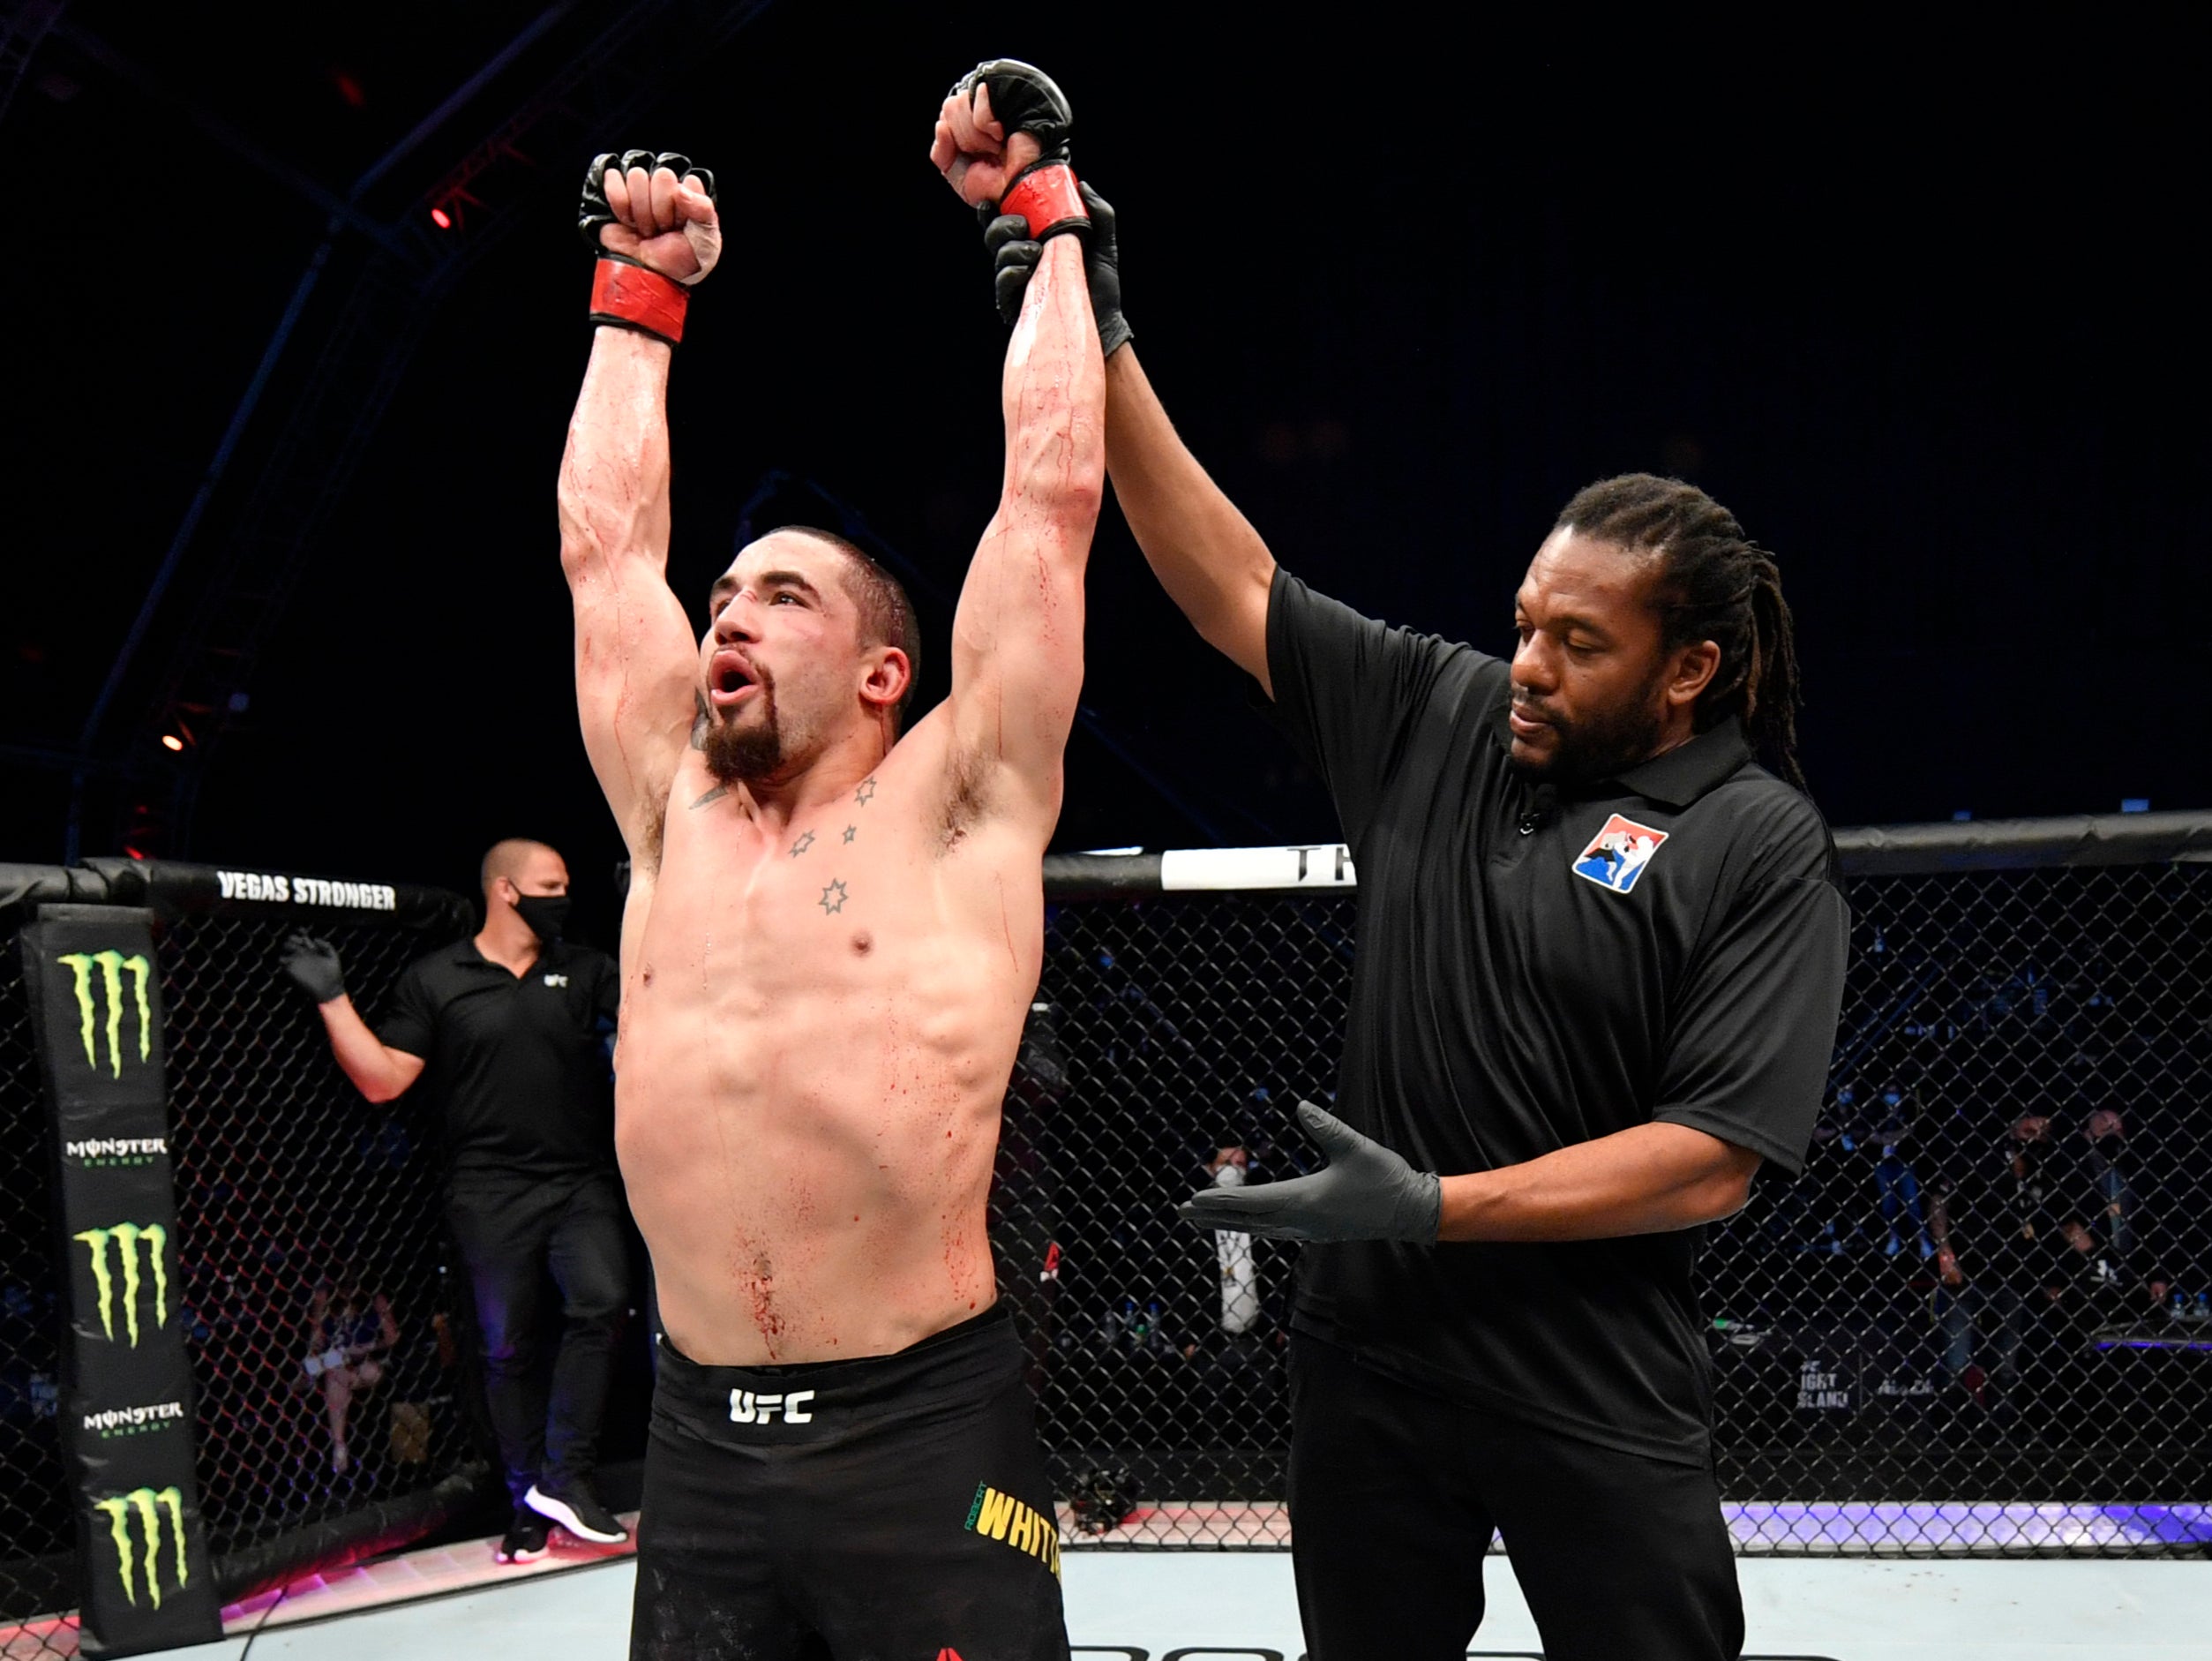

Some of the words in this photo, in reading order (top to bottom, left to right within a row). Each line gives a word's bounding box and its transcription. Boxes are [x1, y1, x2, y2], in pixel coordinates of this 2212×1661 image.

[217, 870, 290, 902] VEGAS
[292, 877, 396, 911] STRONGER
[66, 1137, 168, 1158] MONSTER
[83, 1402, 184, 1430] MONSTER
[730, 1387, 814, 1424] UFC
[964, 1480, 987, 1531] ROBERT
